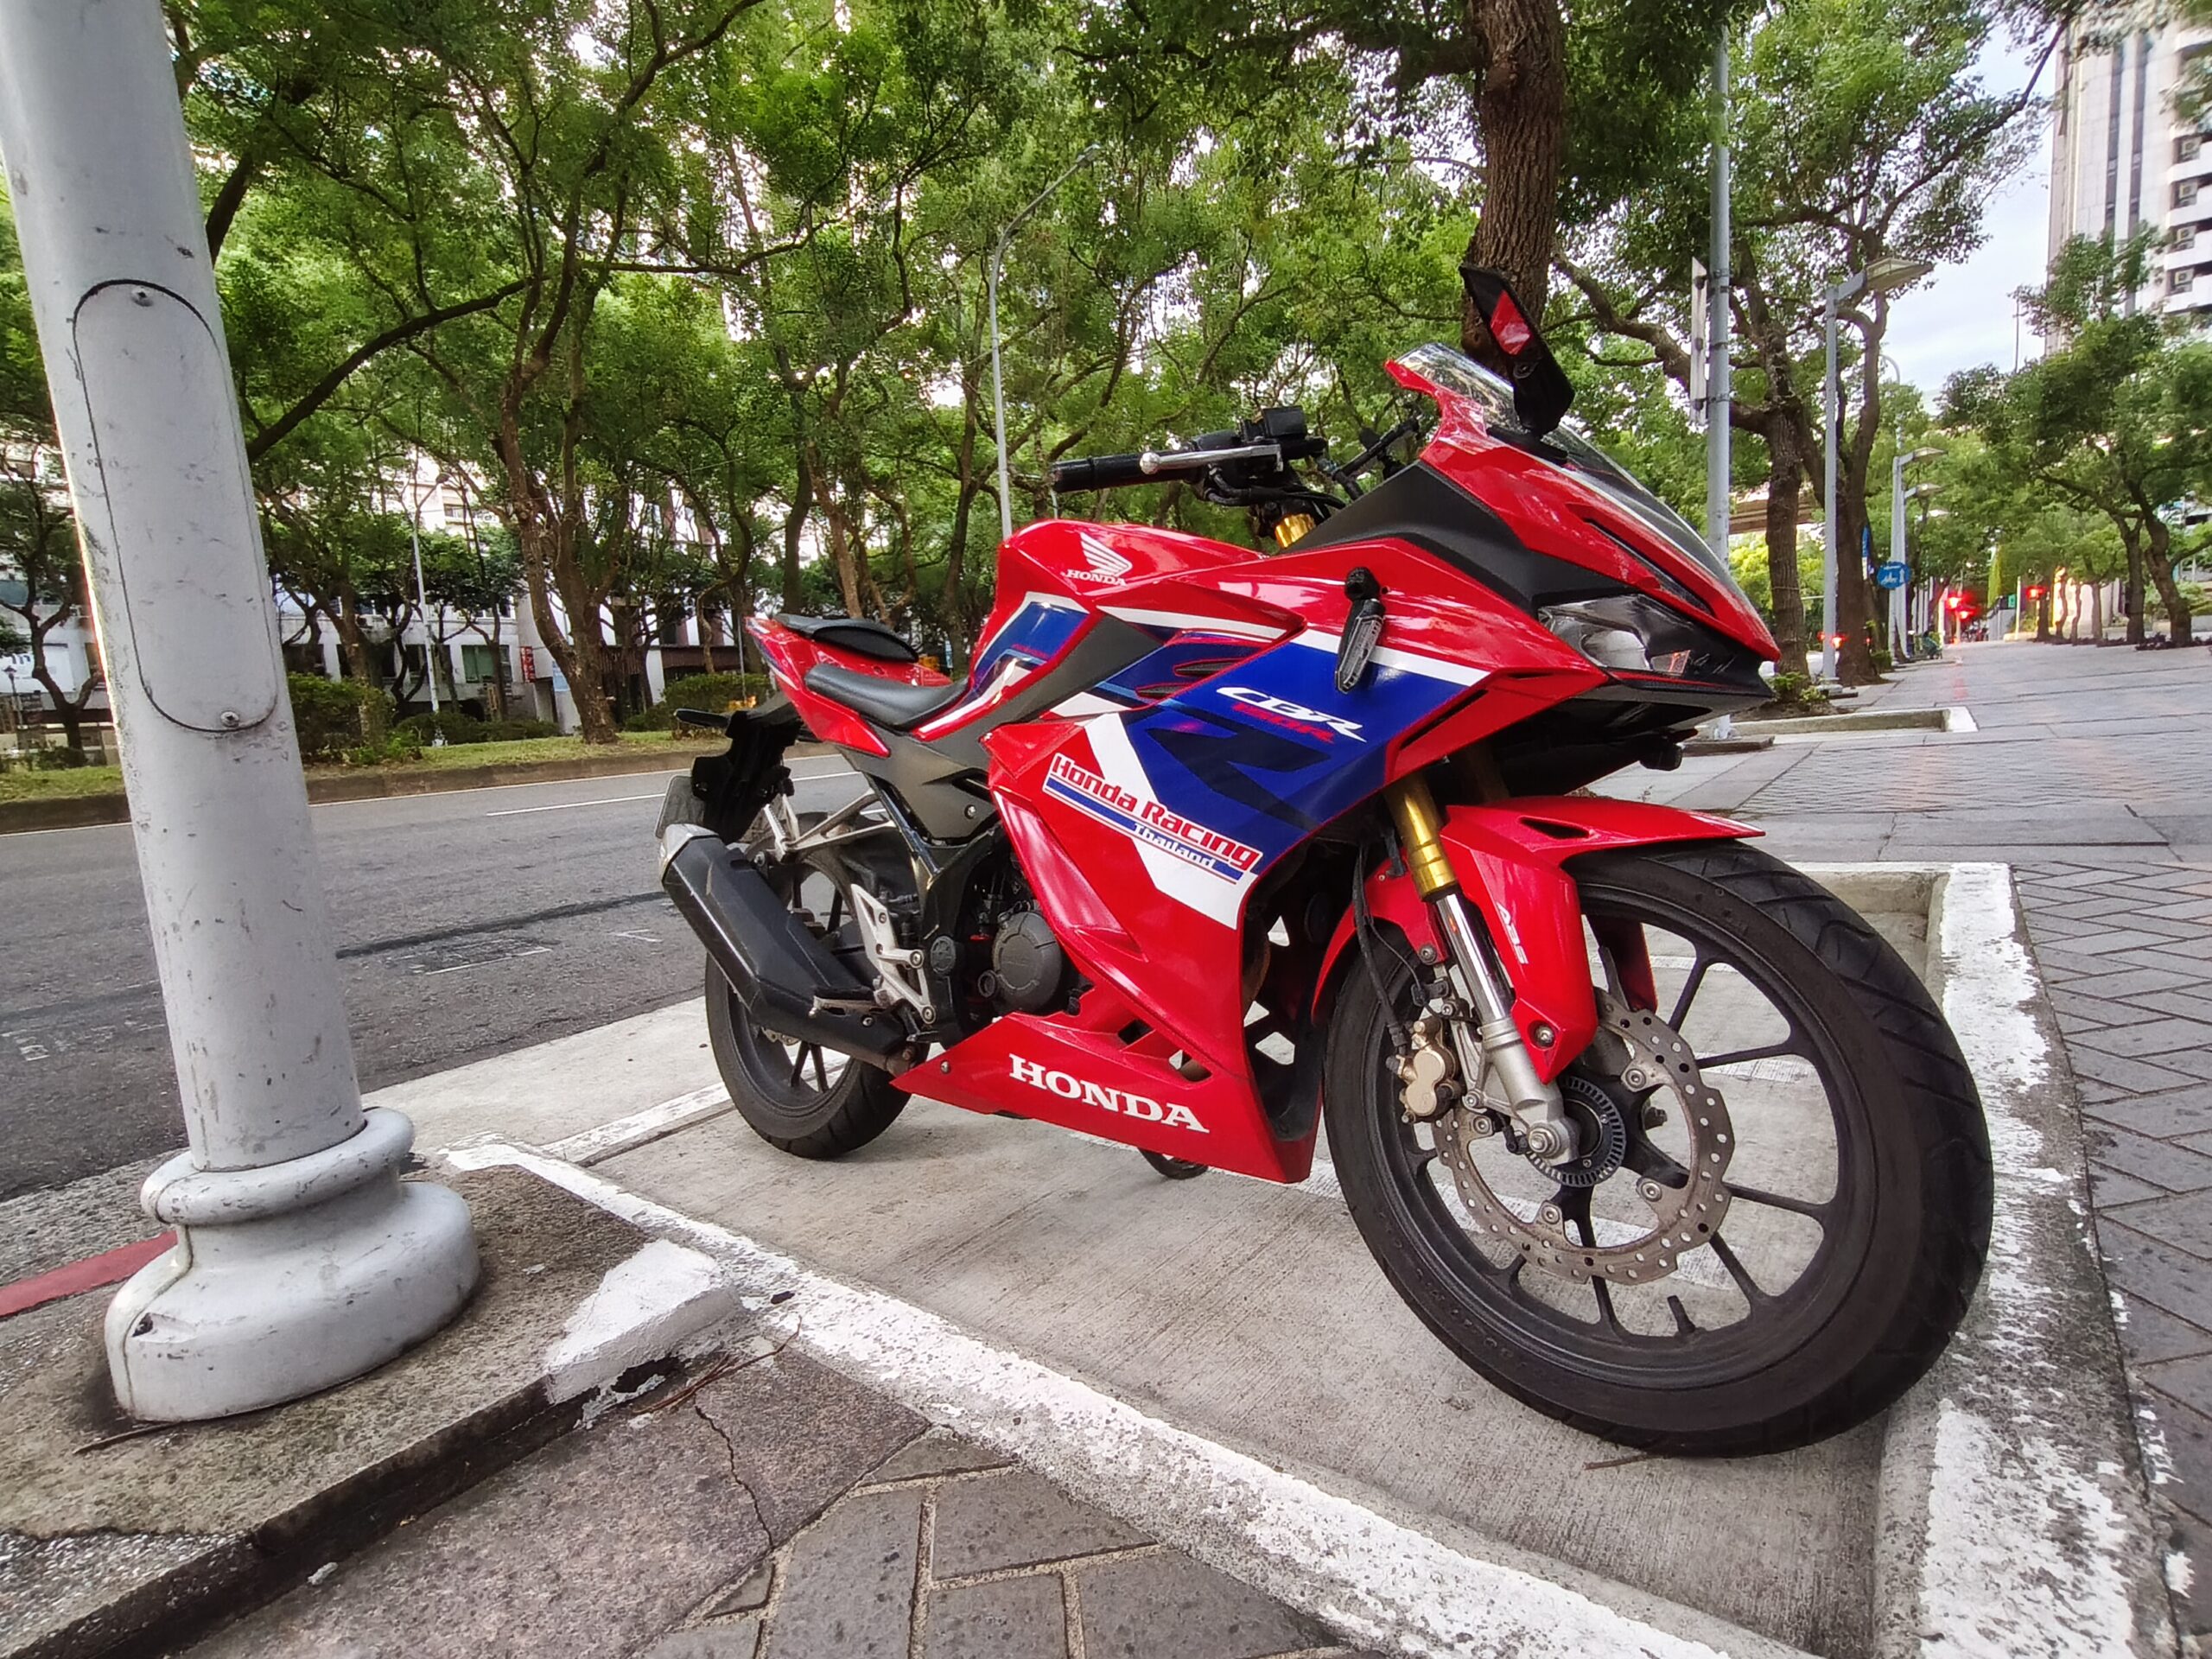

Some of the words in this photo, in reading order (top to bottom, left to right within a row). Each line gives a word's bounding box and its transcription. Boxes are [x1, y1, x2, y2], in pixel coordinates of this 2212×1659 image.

[1065, 568, 1127, 588] HONDA
[1216, 687, 1368, 743] CBR
[1051, 755, 1138, 812] Honda
[1141, 800, 1261, 872] Racing
[1133, 822, 1217, 868] Thailand
[1496, 901, 1529, 964] ABS
[1008, 1052, 1210, 1134] HONDA
